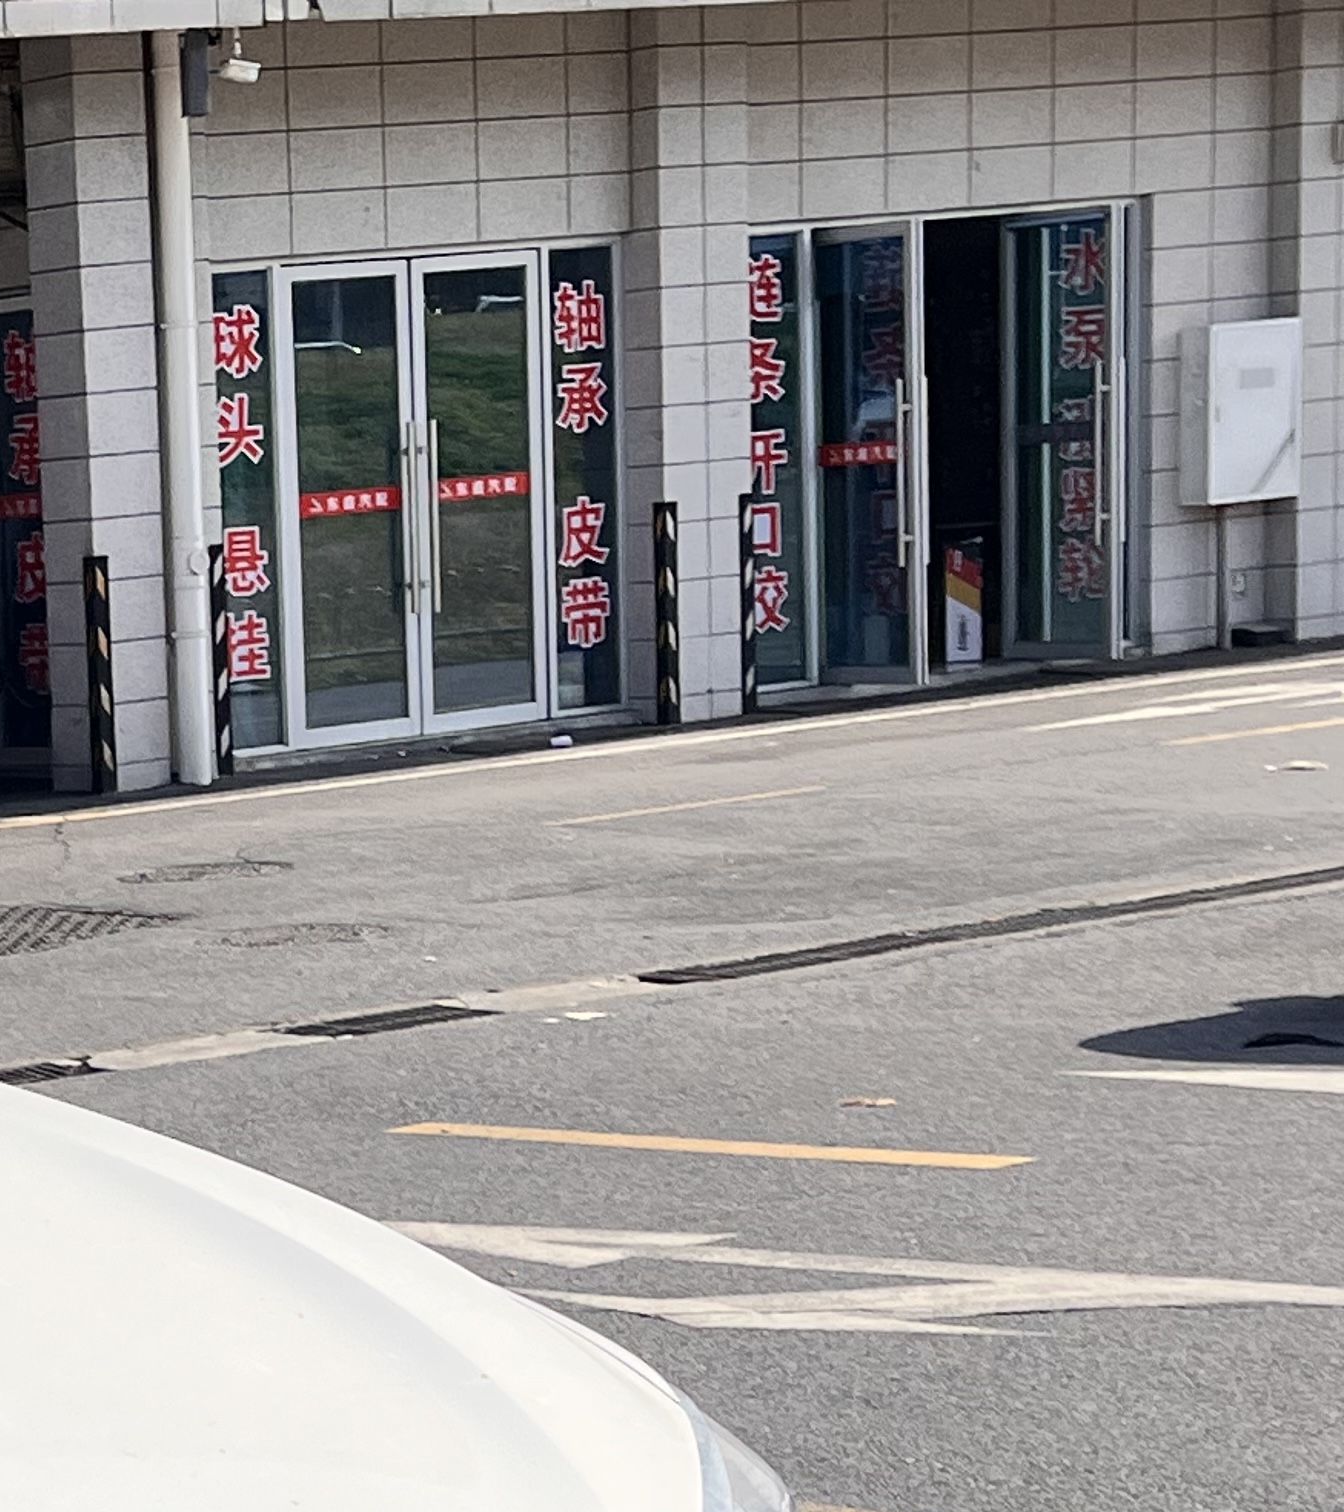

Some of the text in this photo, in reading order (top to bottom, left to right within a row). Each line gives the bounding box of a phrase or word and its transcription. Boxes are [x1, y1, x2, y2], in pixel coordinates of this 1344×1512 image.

[212, 303, 264, 467] 球头
[554, 279, 610, 649] 轴承 皮带
